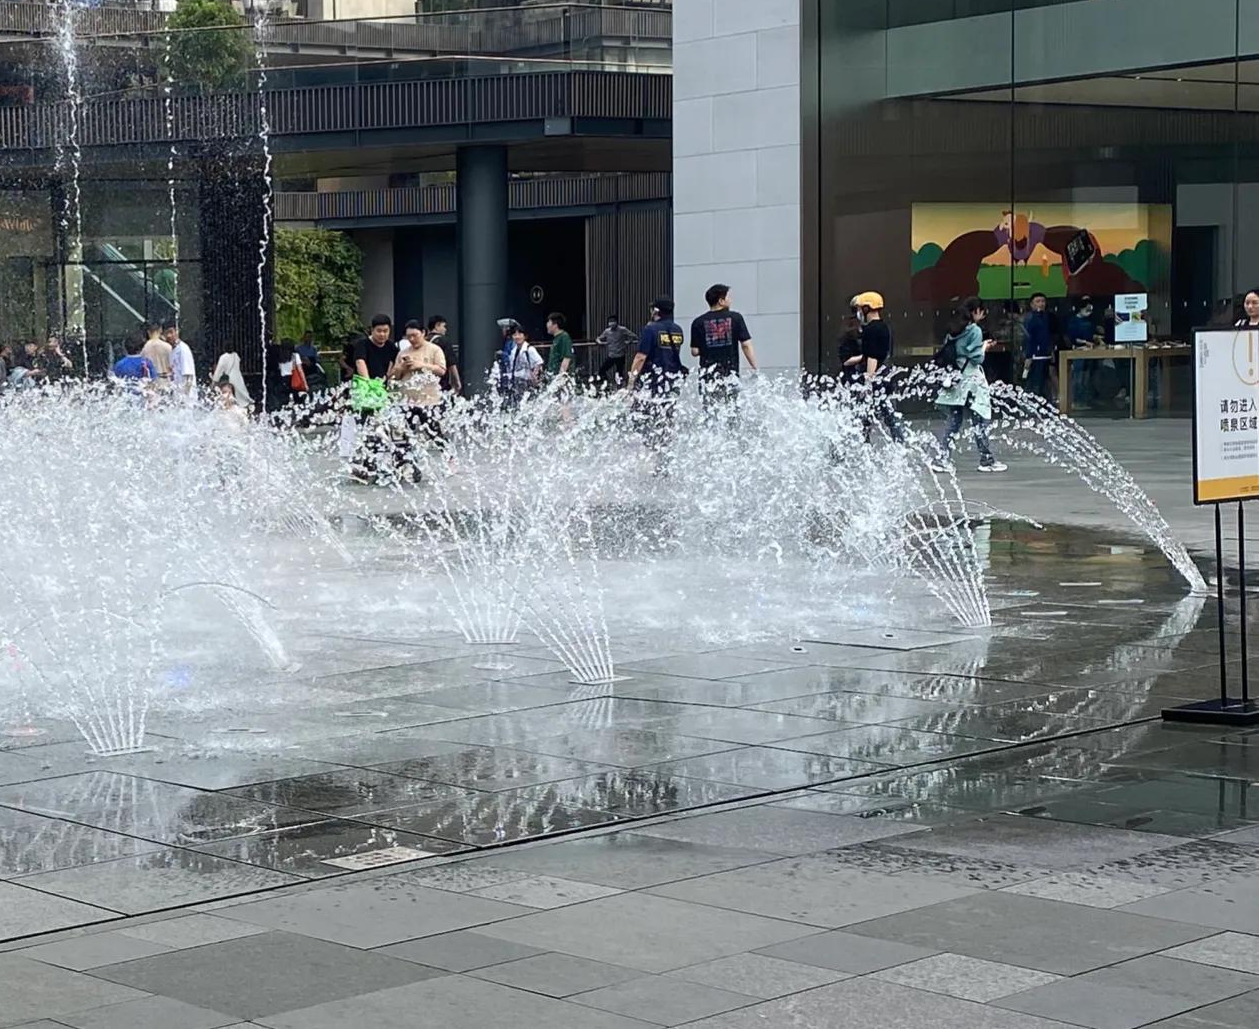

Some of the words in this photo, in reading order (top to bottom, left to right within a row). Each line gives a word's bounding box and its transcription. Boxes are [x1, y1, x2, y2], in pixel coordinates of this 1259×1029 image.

[1221, 398, 1258, 413] 请勿进入
[1221, 416, 1258, 432] 喷泉区域
